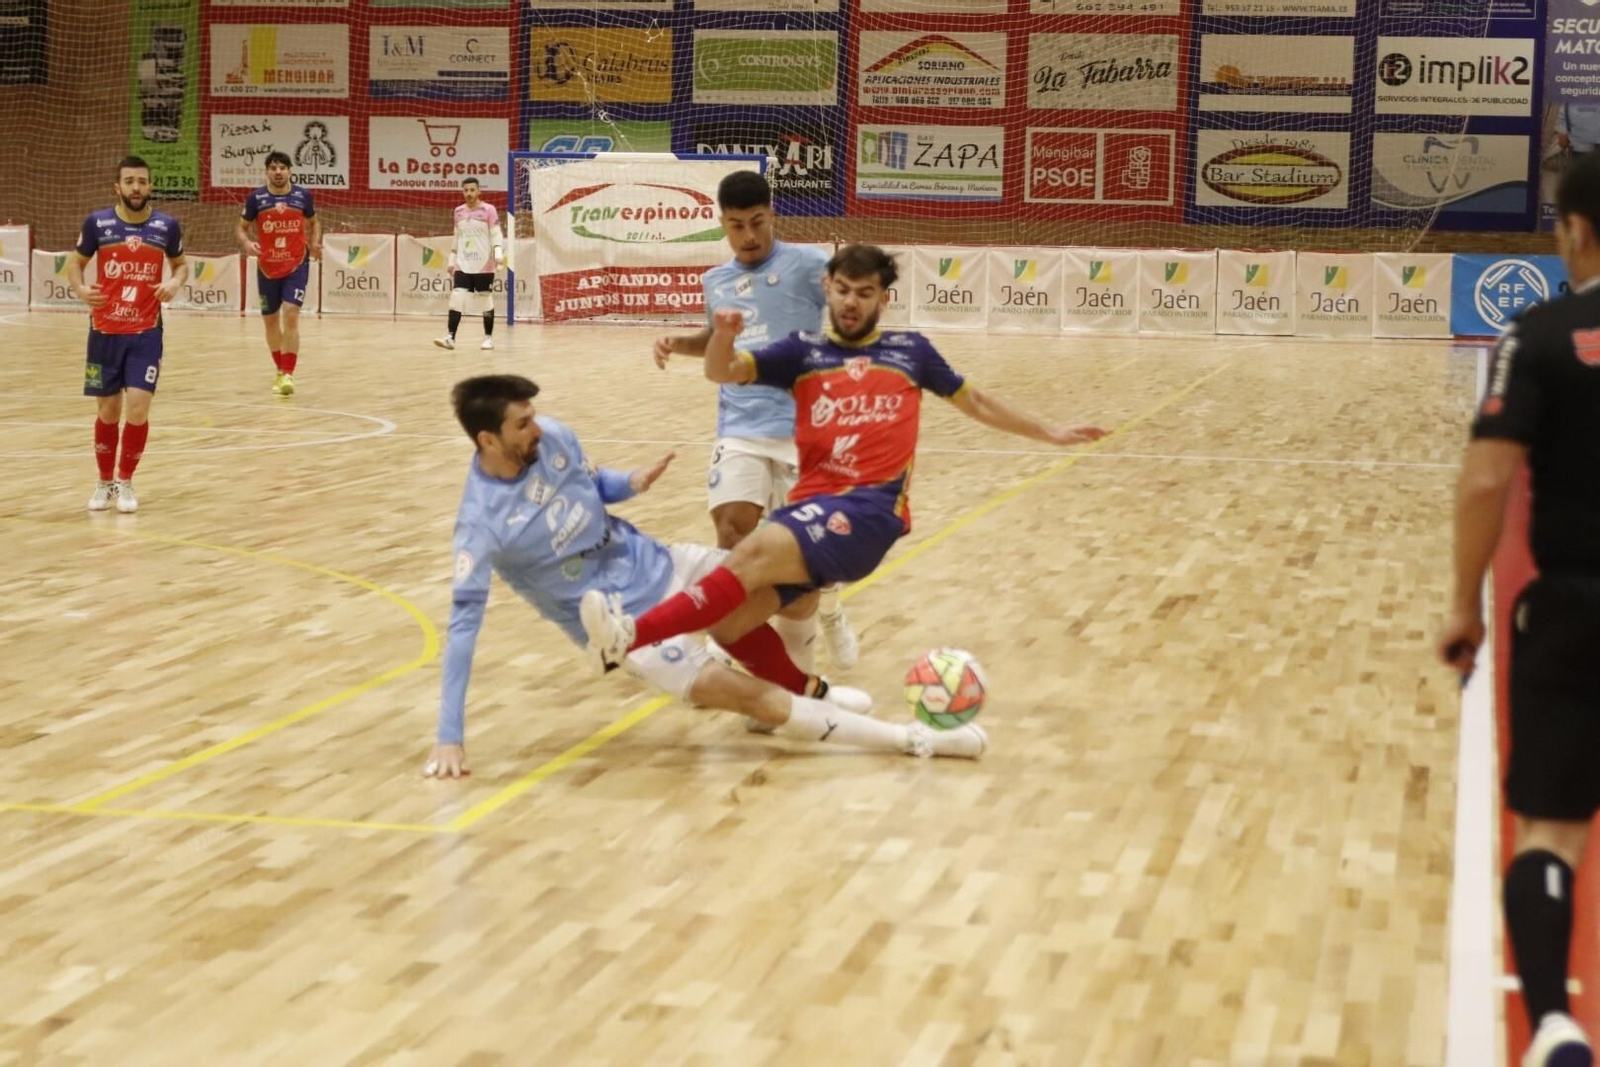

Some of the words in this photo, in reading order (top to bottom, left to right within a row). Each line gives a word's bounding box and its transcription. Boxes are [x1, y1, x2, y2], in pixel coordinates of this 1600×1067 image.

[1552, 18, 1600, 34] SECU
[450, 55, 496, 63] CONNECT
[917, 61, 965, 71] SORIANO
[933, 76, 1001, 86] INDUSTRIALES
[1419, 54, 1530, 91] implik2
[1378, 95, 1418, 103] SERVICIOS
[1482, 97, 1528, 105] PUBLICIDAD
[1561, 86, 1600, 97] segurid
[914, 142, 999, 169] ZAPA
[378, 157, 399, 173] La
[407, 158, 499, 179] Despensa
[1033, 167, 1094, 187] PSOE
[1209, 167, 1245, 182] Bar
[1251, 167, 1335, 183] Stadium
[289, 173, 346, 185] ORENITA
[390, 179, 427, 187] PORQUE
[771, 179, 832, 189] STAURANTE
[335, 270, 380, 290] Jaén
[577, 273, 672, 290] APOYANDO
[183, 284, 227, 304] Jaén
[554, 292, 619, 313] JUNTOS
[622, 293, 649, 306] UN
[654, 292, 706, 307] EQUI
[926, 283, 973, 304] Jaén
[1001, 285, 1048, 306] Jaén
[1076, 286, 1124, 308] Jaén
[1151, 289, 1199, 309] Jaén
[1232, 289, 1280, 311] Jaén
[1310, 292, 1359, 313] Jaén
[1389, 293, 1437, 314] Jaén
[145, 365, 157, 384] 8
[790, 503, 825, 522] 5
